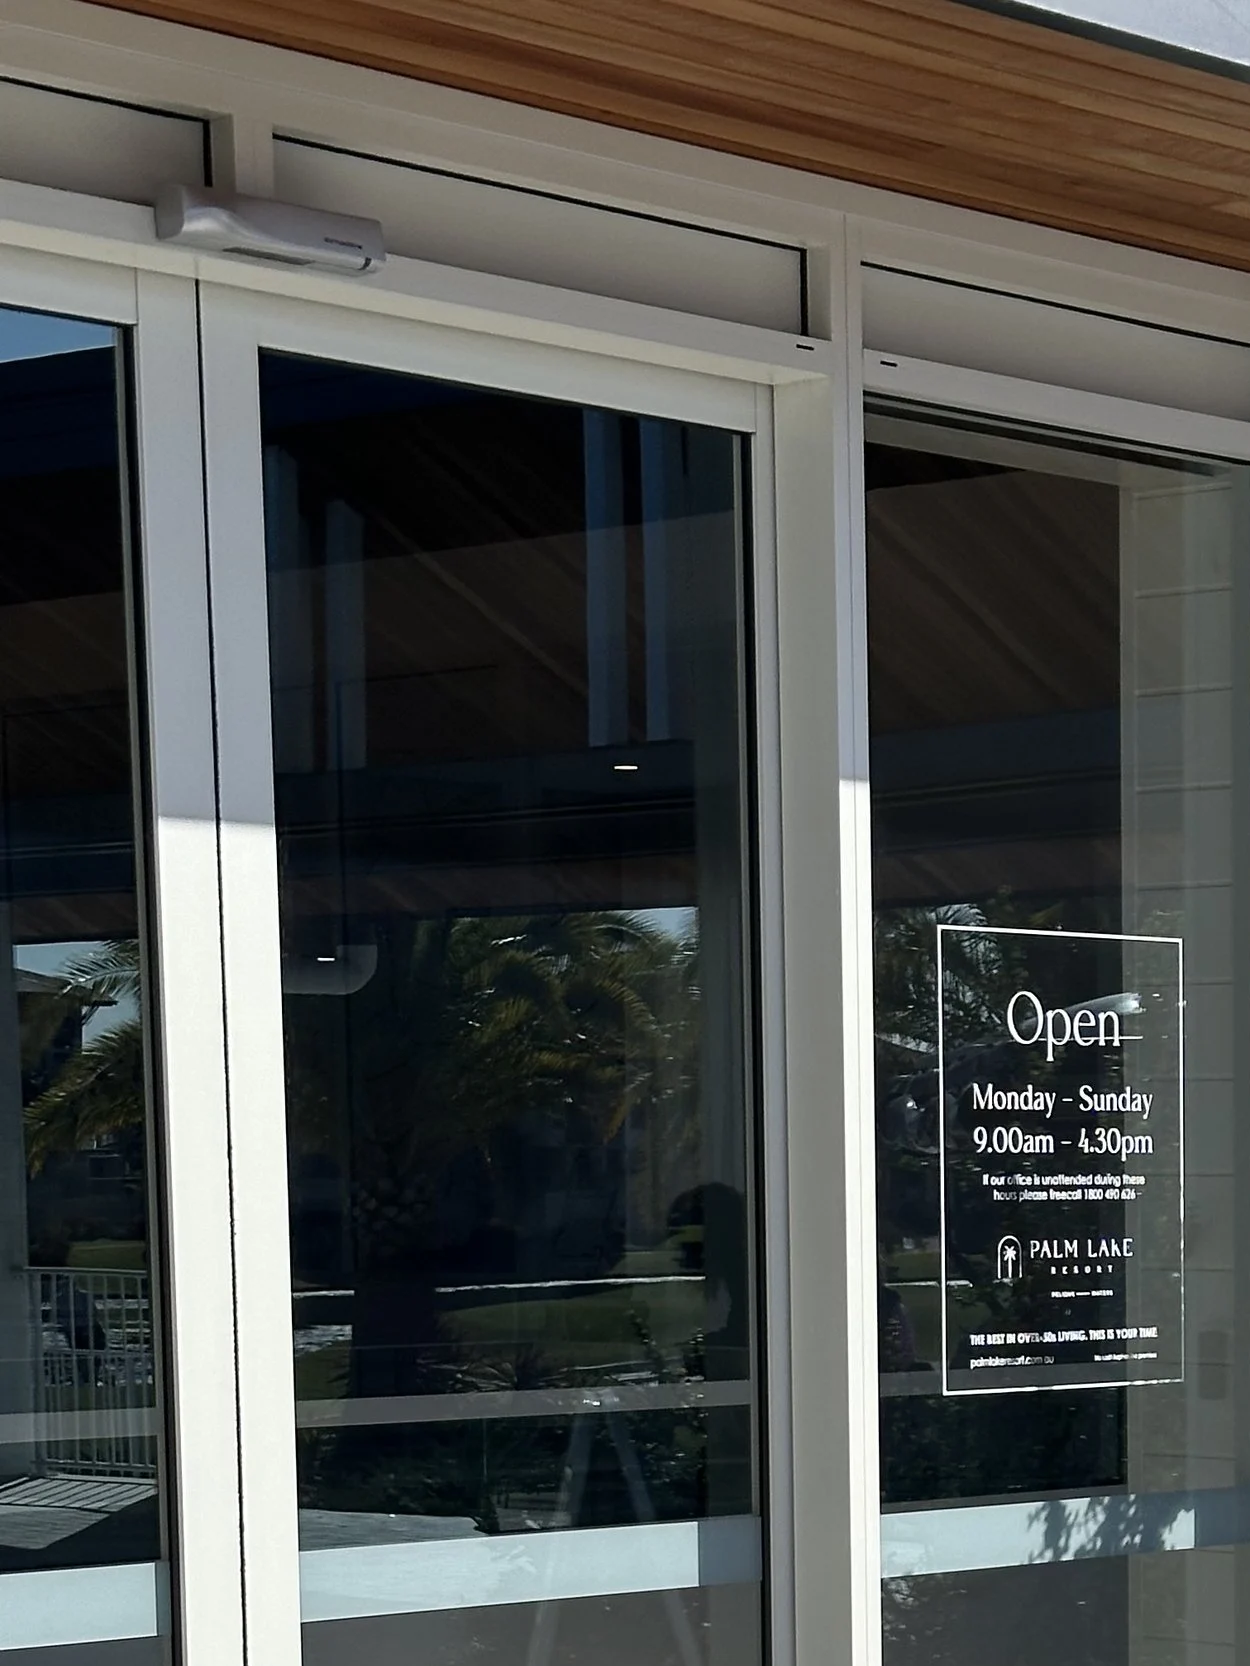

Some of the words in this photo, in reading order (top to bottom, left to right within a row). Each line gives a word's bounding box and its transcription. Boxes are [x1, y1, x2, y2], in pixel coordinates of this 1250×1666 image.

[1007, 991, 1120, 1061] Open
[973, 1083, 1056, 1118] Monday
[1079, 1085, 1153, 1119] Sunday
[973, 1127, 1054, 1153] 9.00am
[1078, 1128, 1153, 1161] 4.30pm
[990, 1176, 1005, 1185] our
[1007, 1174, 1032, 1185] office
[1034, 1174, 1040, 1185] is
[1042, 1174, 1092, 1185] unattended
[1094, 1173, 1121, 1187] during
[1122, 1174, 1146, 1185] these
[993, 1189, 1017, 1200] hours
[1019, 1189, 1048, 1202] please
[1049, 1188, 1082, 1200] freecall
[1084, 1189, 1103, 1200] 1800
[1030, 1240, 1078, 1259] PALM
[1087, 1238, 1134, 1258] LAKE
[1051, 1265, 1114, 1275] RESORT
[970, 1334, 986, 1346] THE
[987, 1333, 1005, 1345] BEST
[1007, 1334, 1017, 1344] IN
[1058, 1330, 1088, 1342] LIVING.
[1089, 1329, 1106, 1340] THIS
[1107, 1329, 1115, 1340] IS
[1116, 1328, 1139, 1340] YOUR
